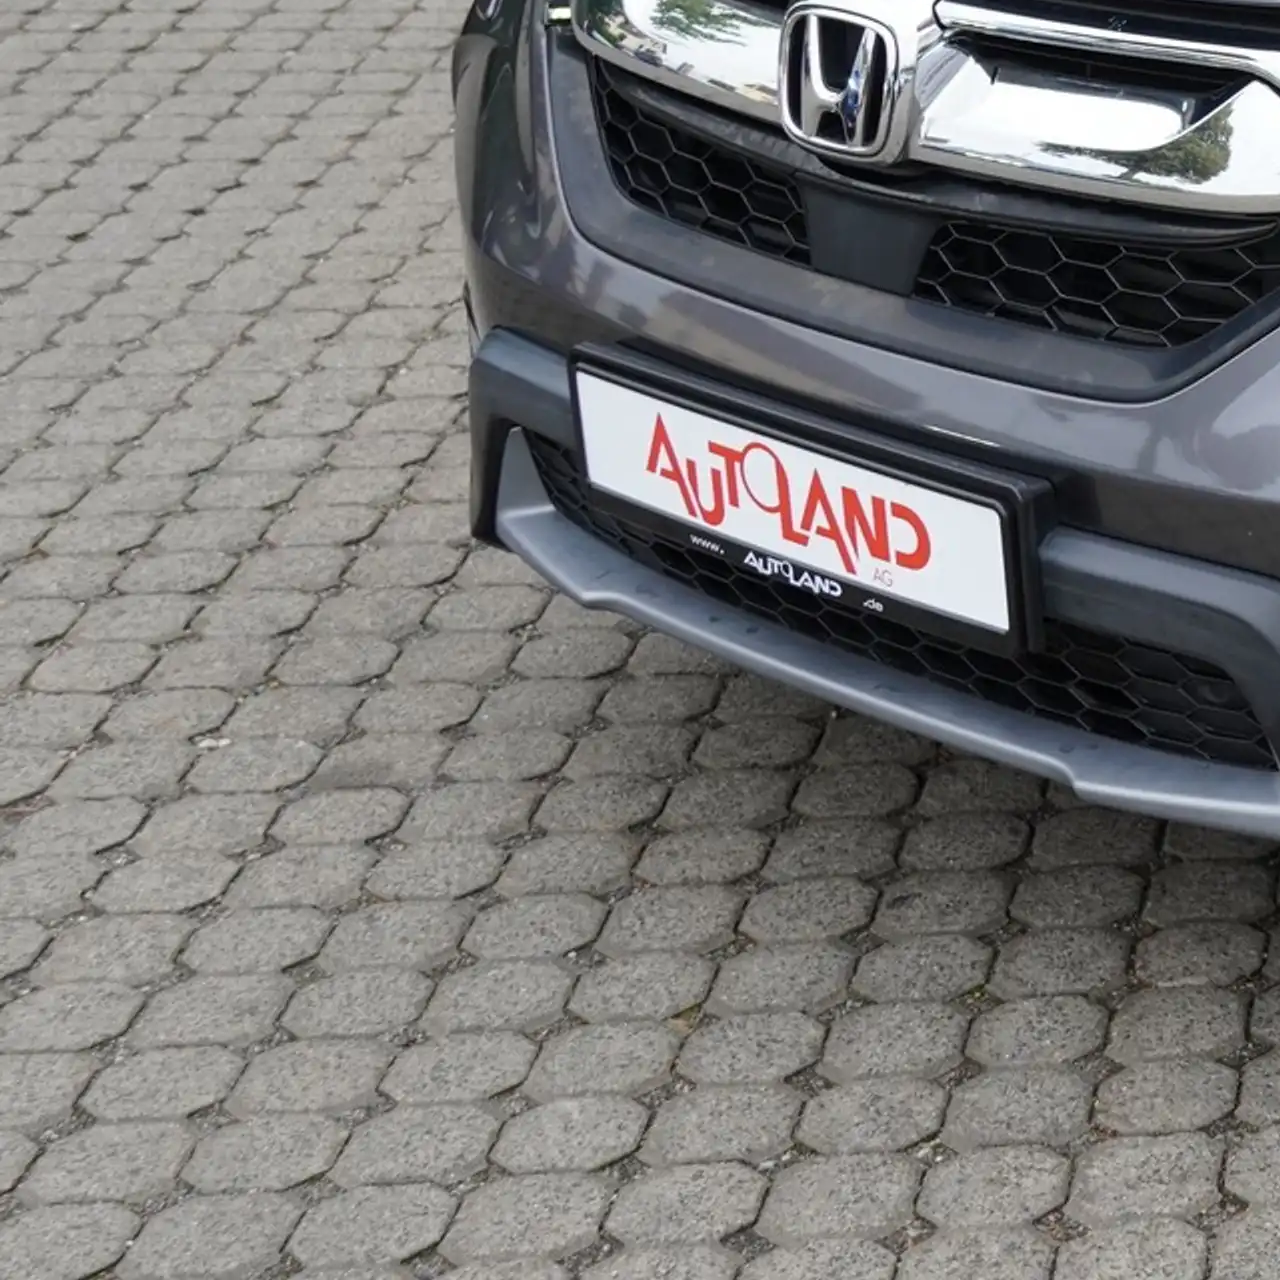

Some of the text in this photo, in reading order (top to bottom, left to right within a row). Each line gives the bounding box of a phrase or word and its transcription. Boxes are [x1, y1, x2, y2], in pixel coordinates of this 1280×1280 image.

[645, 411, 932, 574] AUTOLAND
[689, 533, 725, 555] www.
[743, 551, 843, 598] AUTOLAND
[873, 567, 894, 588] AG
